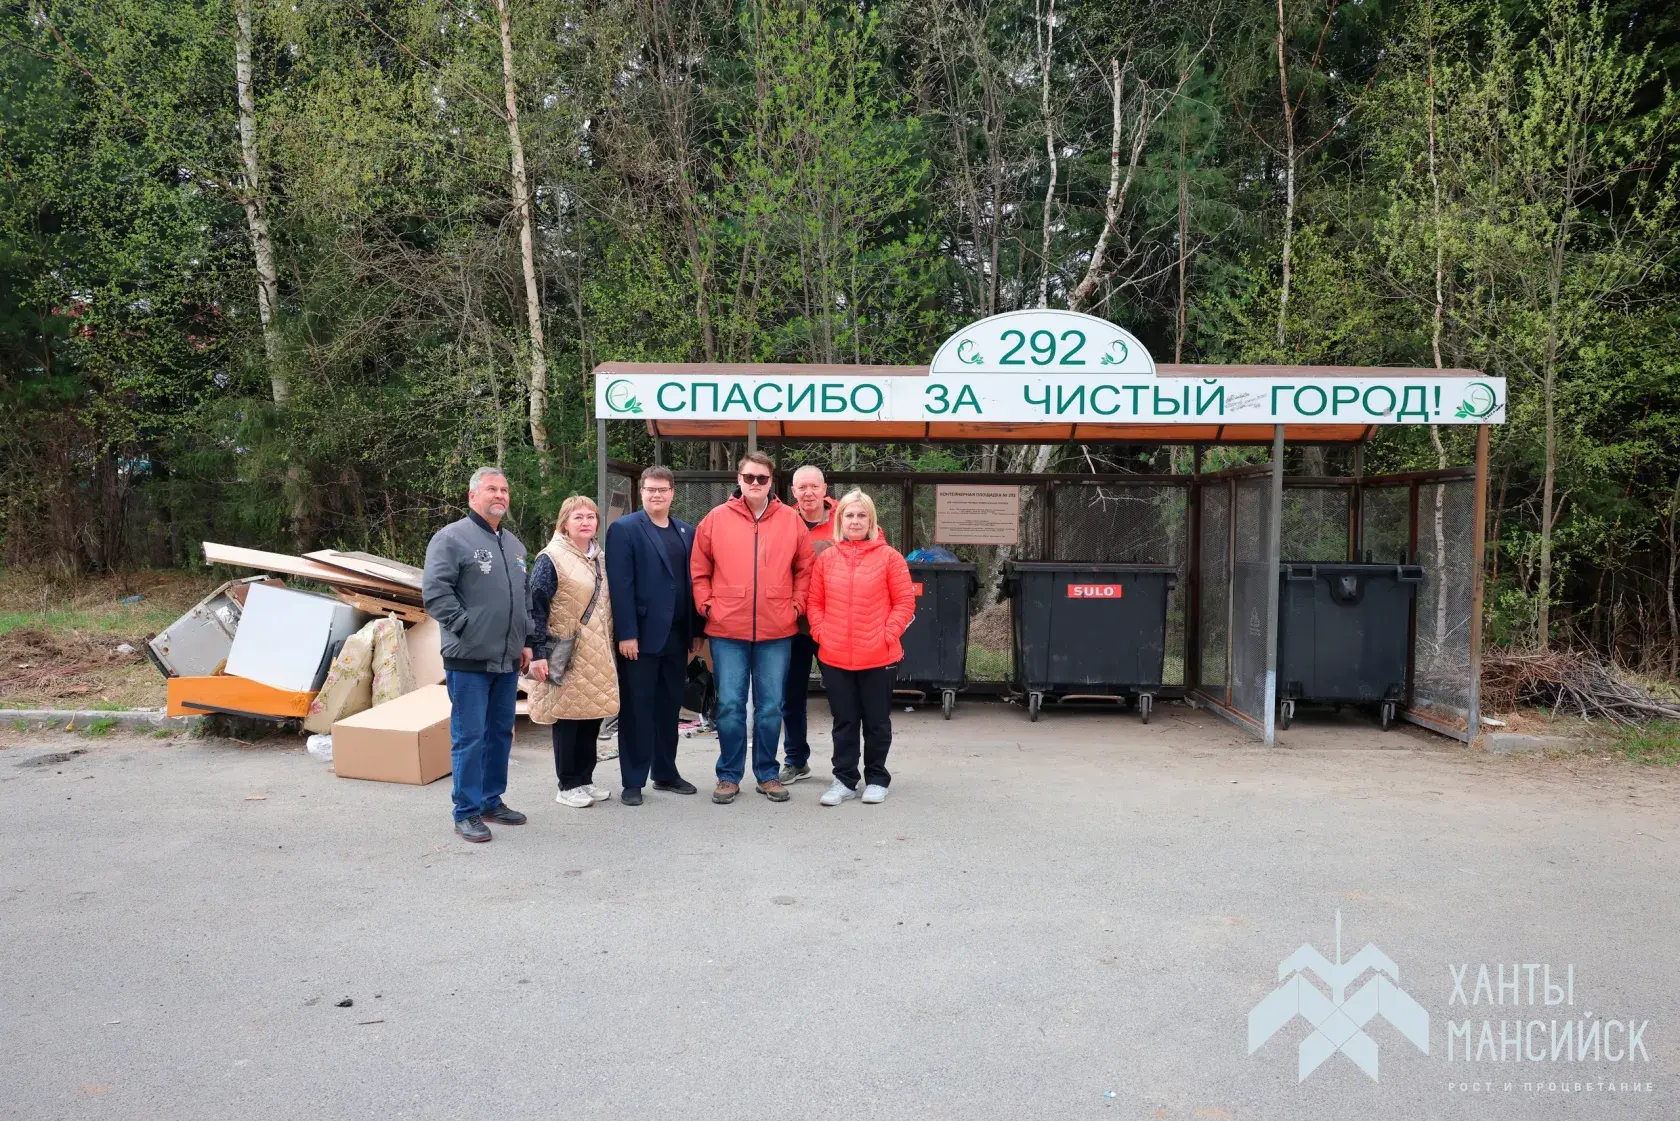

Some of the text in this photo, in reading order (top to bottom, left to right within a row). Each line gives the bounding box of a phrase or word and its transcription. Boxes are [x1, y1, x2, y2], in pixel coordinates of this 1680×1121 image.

[1000, 329, 1086, 367] 292
[656, 381, 884, 415] СПАСИБО
[924, 383, 983, 415] ЗА
[1023, 379, 1225, 416] ЧИСТЫЙ
[1271, 384, 1441, 423] ГОРОД!
[1073, 586, 1114, 597] SULO
